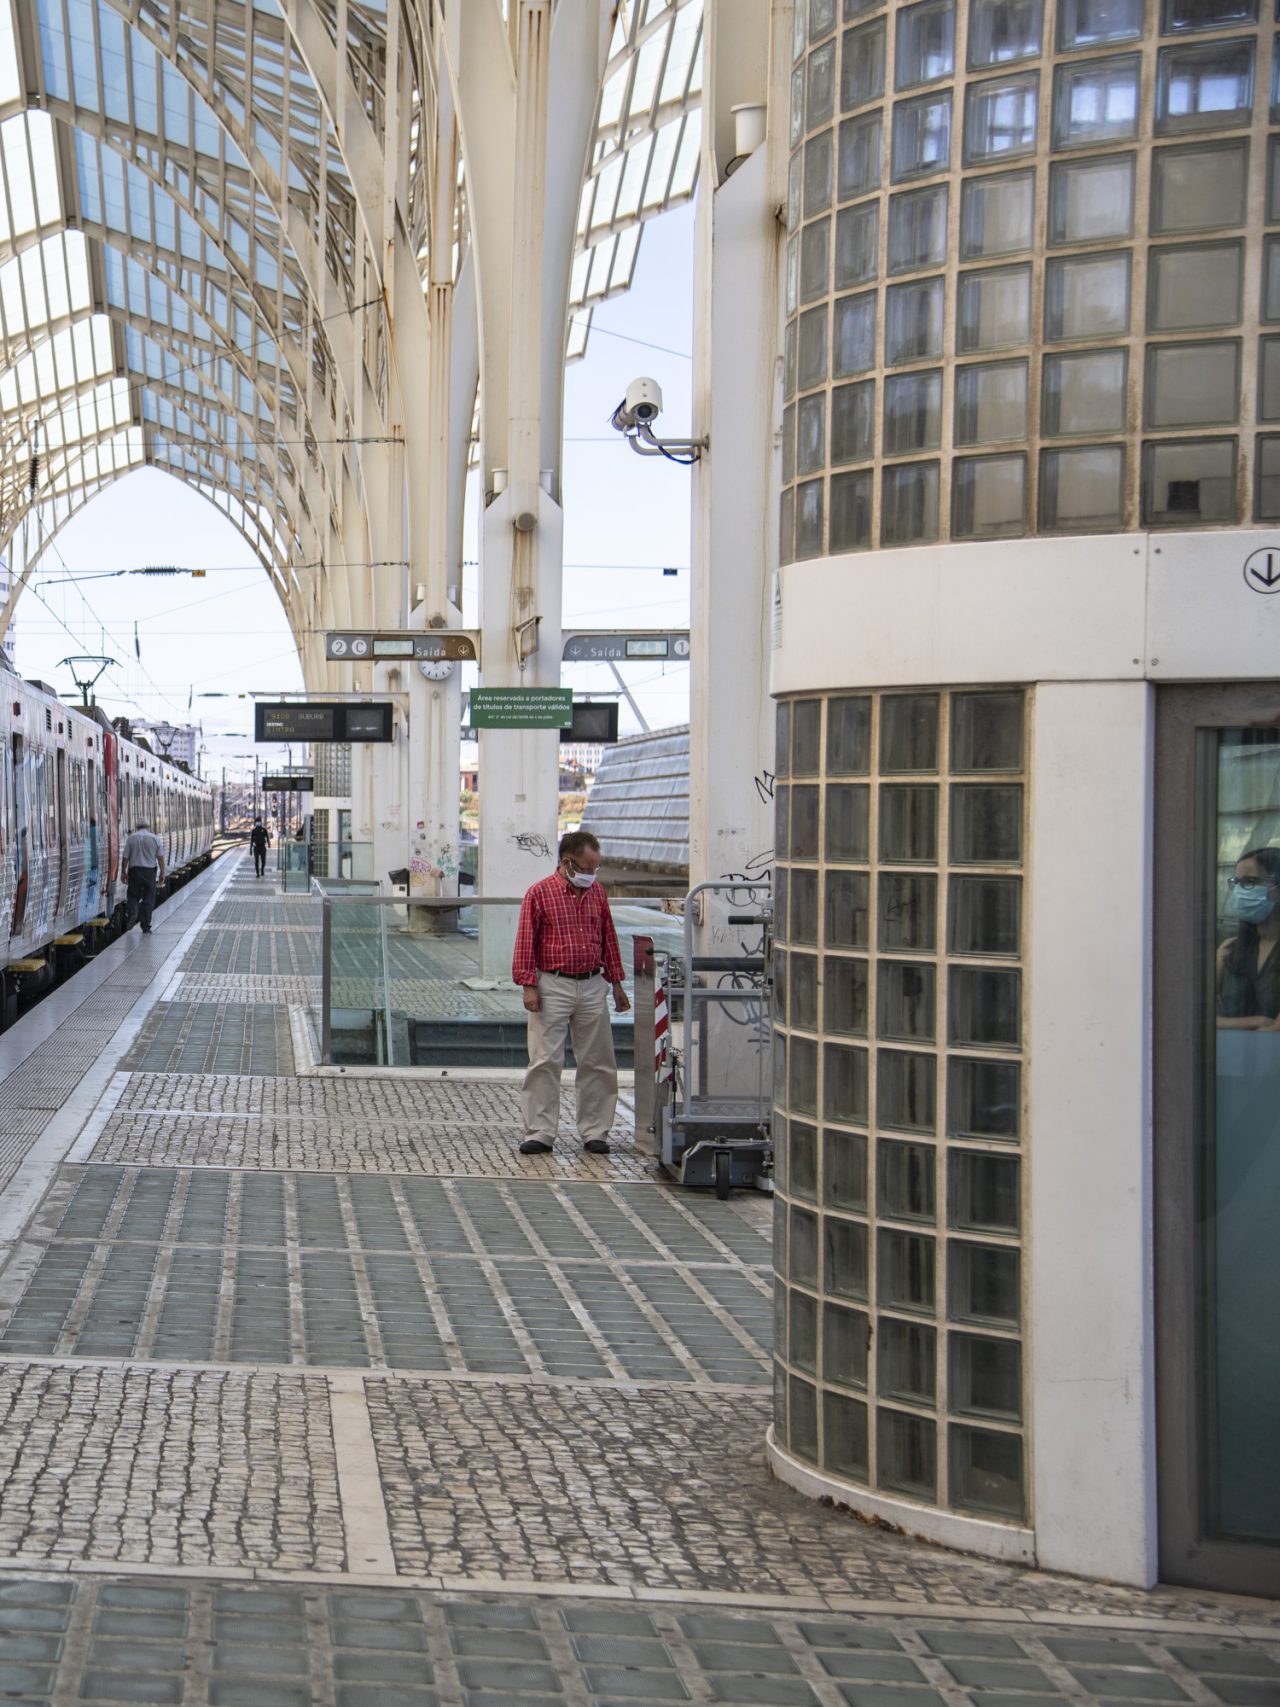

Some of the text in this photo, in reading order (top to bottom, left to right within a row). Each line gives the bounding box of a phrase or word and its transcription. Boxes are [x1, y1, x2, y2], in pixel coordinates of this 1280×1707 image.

[416, 646, 446, 657] Saída
[590, 646, 621, 657] Saída
[531, 695, 565, 703] portadores
[514, 703, 546, 711] transporte
